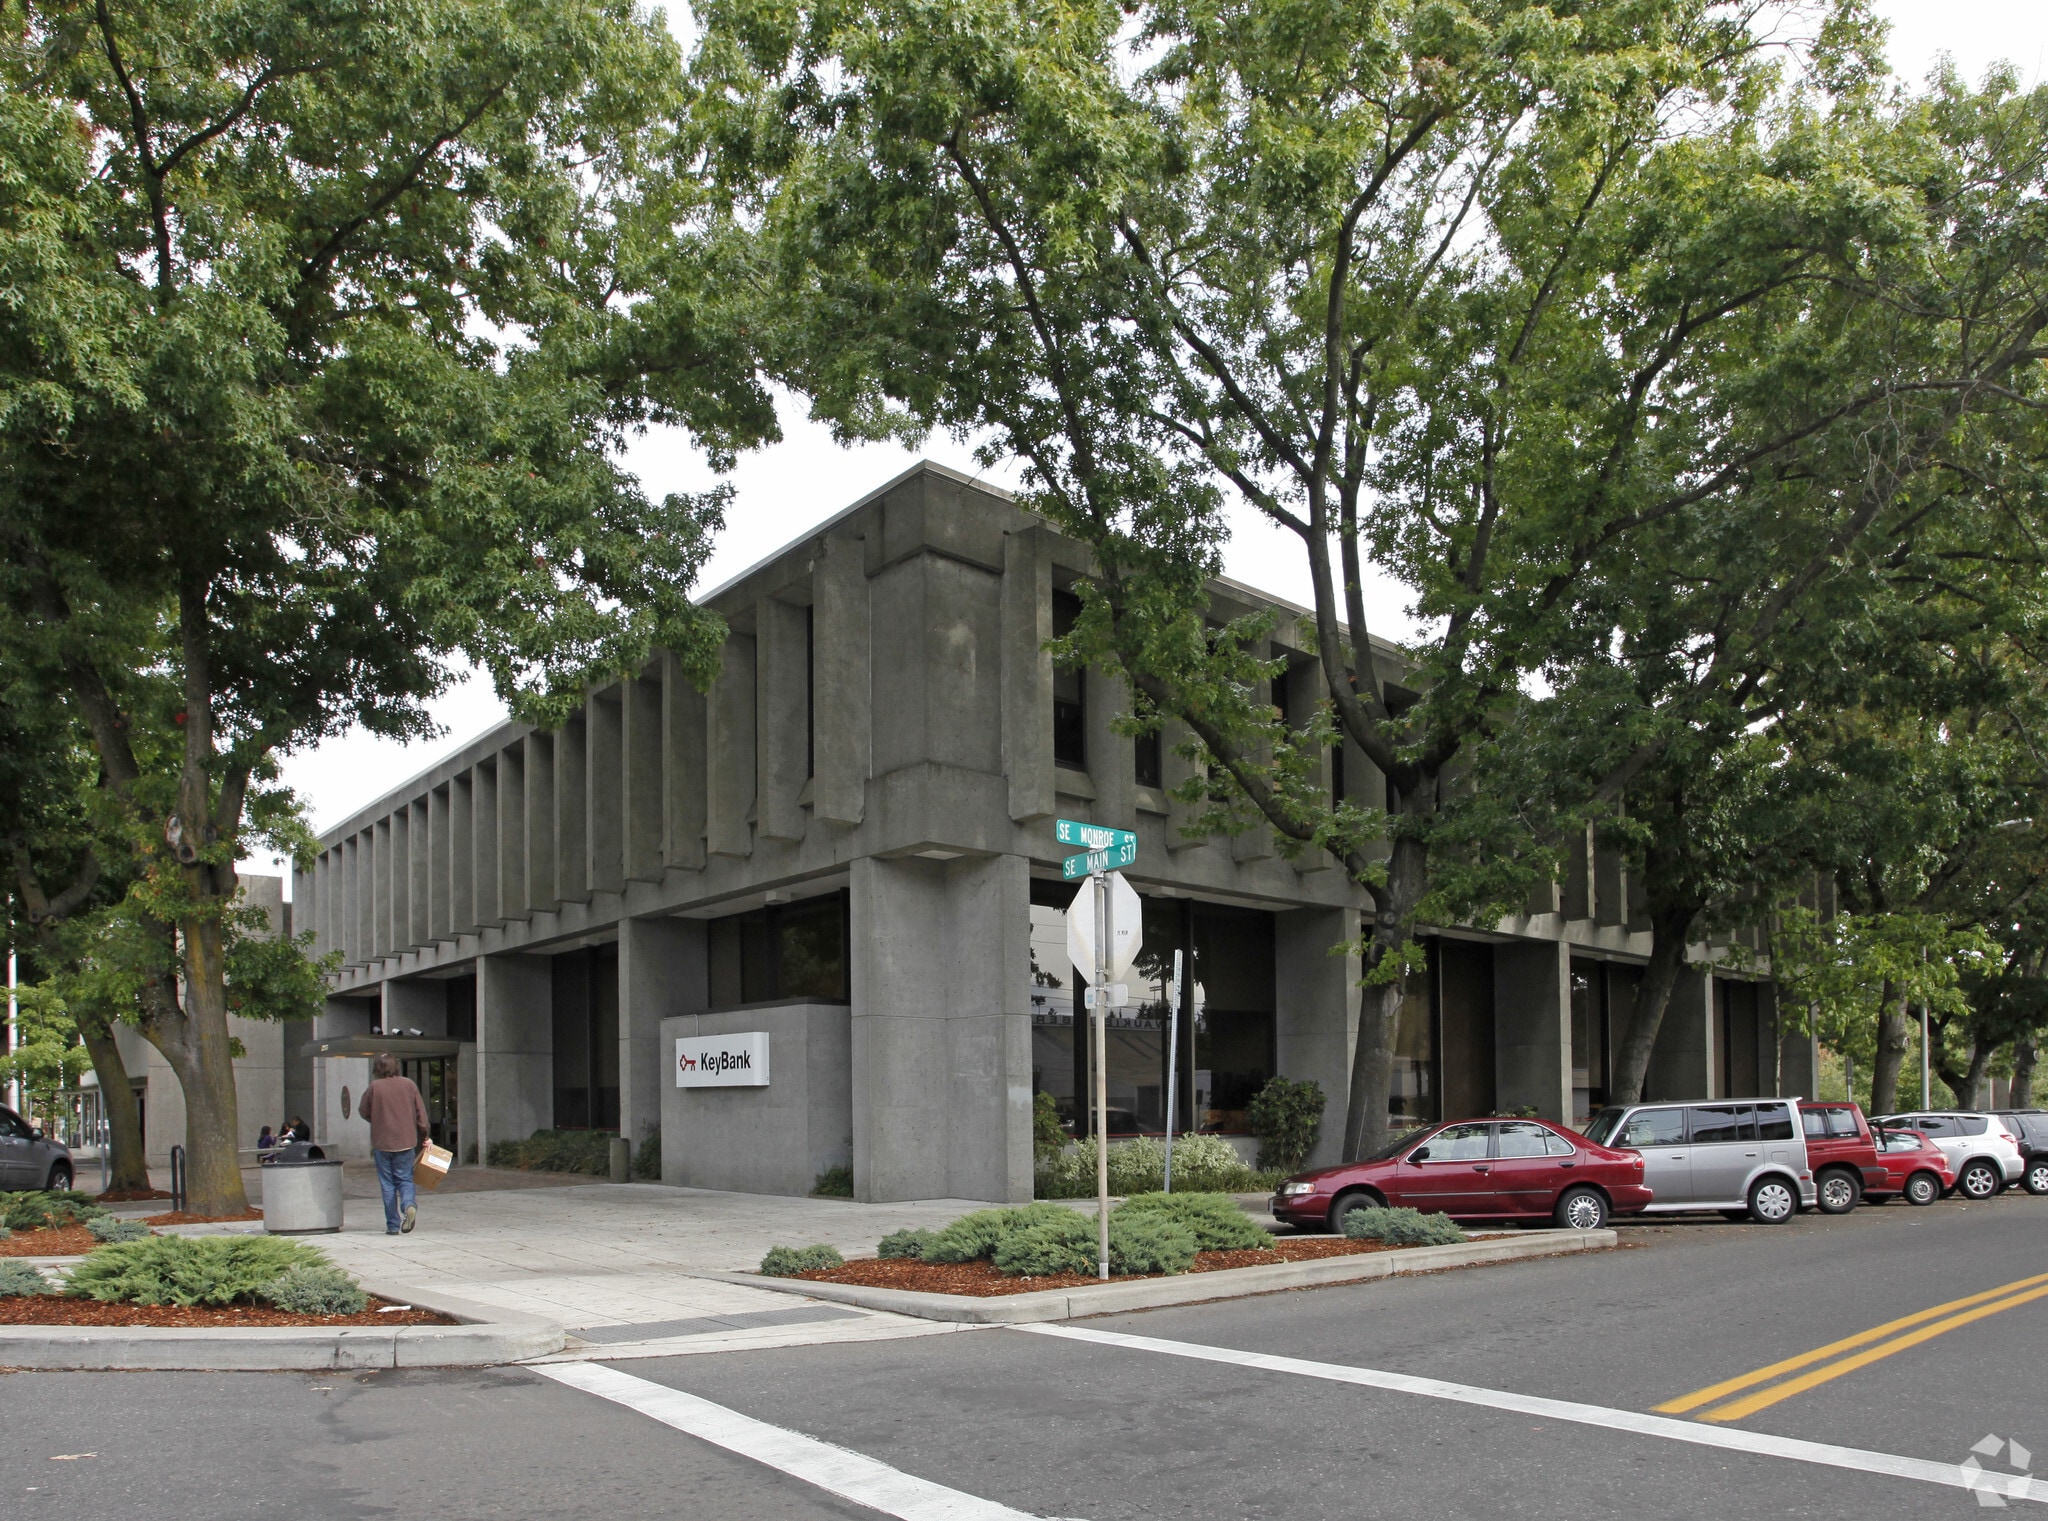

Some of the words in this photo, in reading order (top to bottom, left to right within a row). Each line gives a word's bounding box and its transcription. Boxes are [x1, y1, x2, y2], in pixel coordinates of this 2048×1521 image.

[1059, 823, 1071, 841] SE
[1080, 827, 1115, 847] MONROE
[1065, 859, 1076, 876] SE
[1086, 850, 1109, 871] MAIN
[1120, 844, 1132, 862] ST
[701, 1049, 751, 1076] KeyBank
